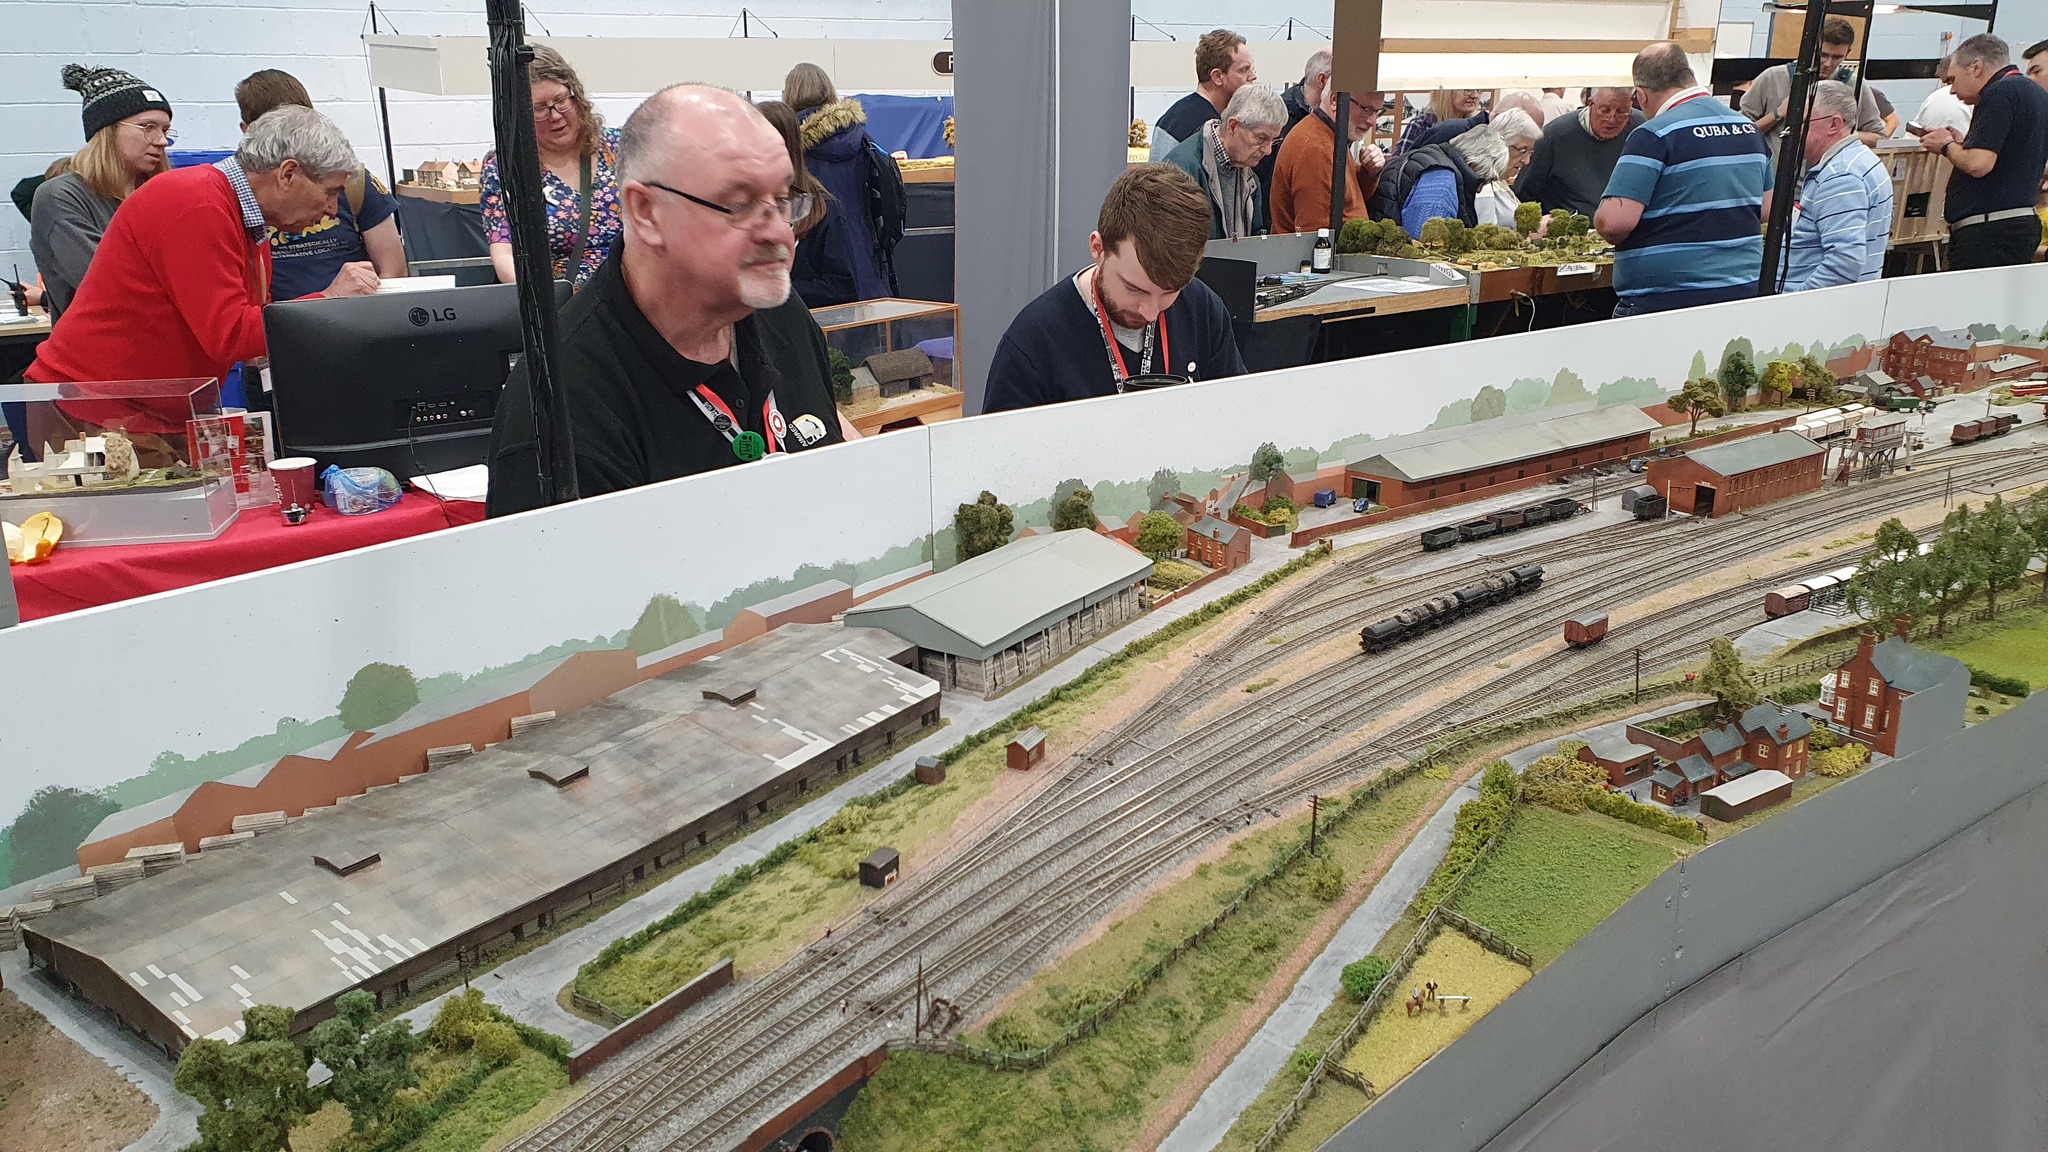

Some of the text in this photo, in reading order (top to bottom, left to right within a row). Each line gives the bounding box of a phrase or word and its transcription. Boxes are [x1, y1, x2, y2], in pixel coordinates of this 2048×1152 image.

[1692, 125, 1730, 139] QUBA
[1731, 124, 1742, 135] &
[288, 238, 338, 250] STRATEGICALLY
[432, 307, 457, 322] LG
